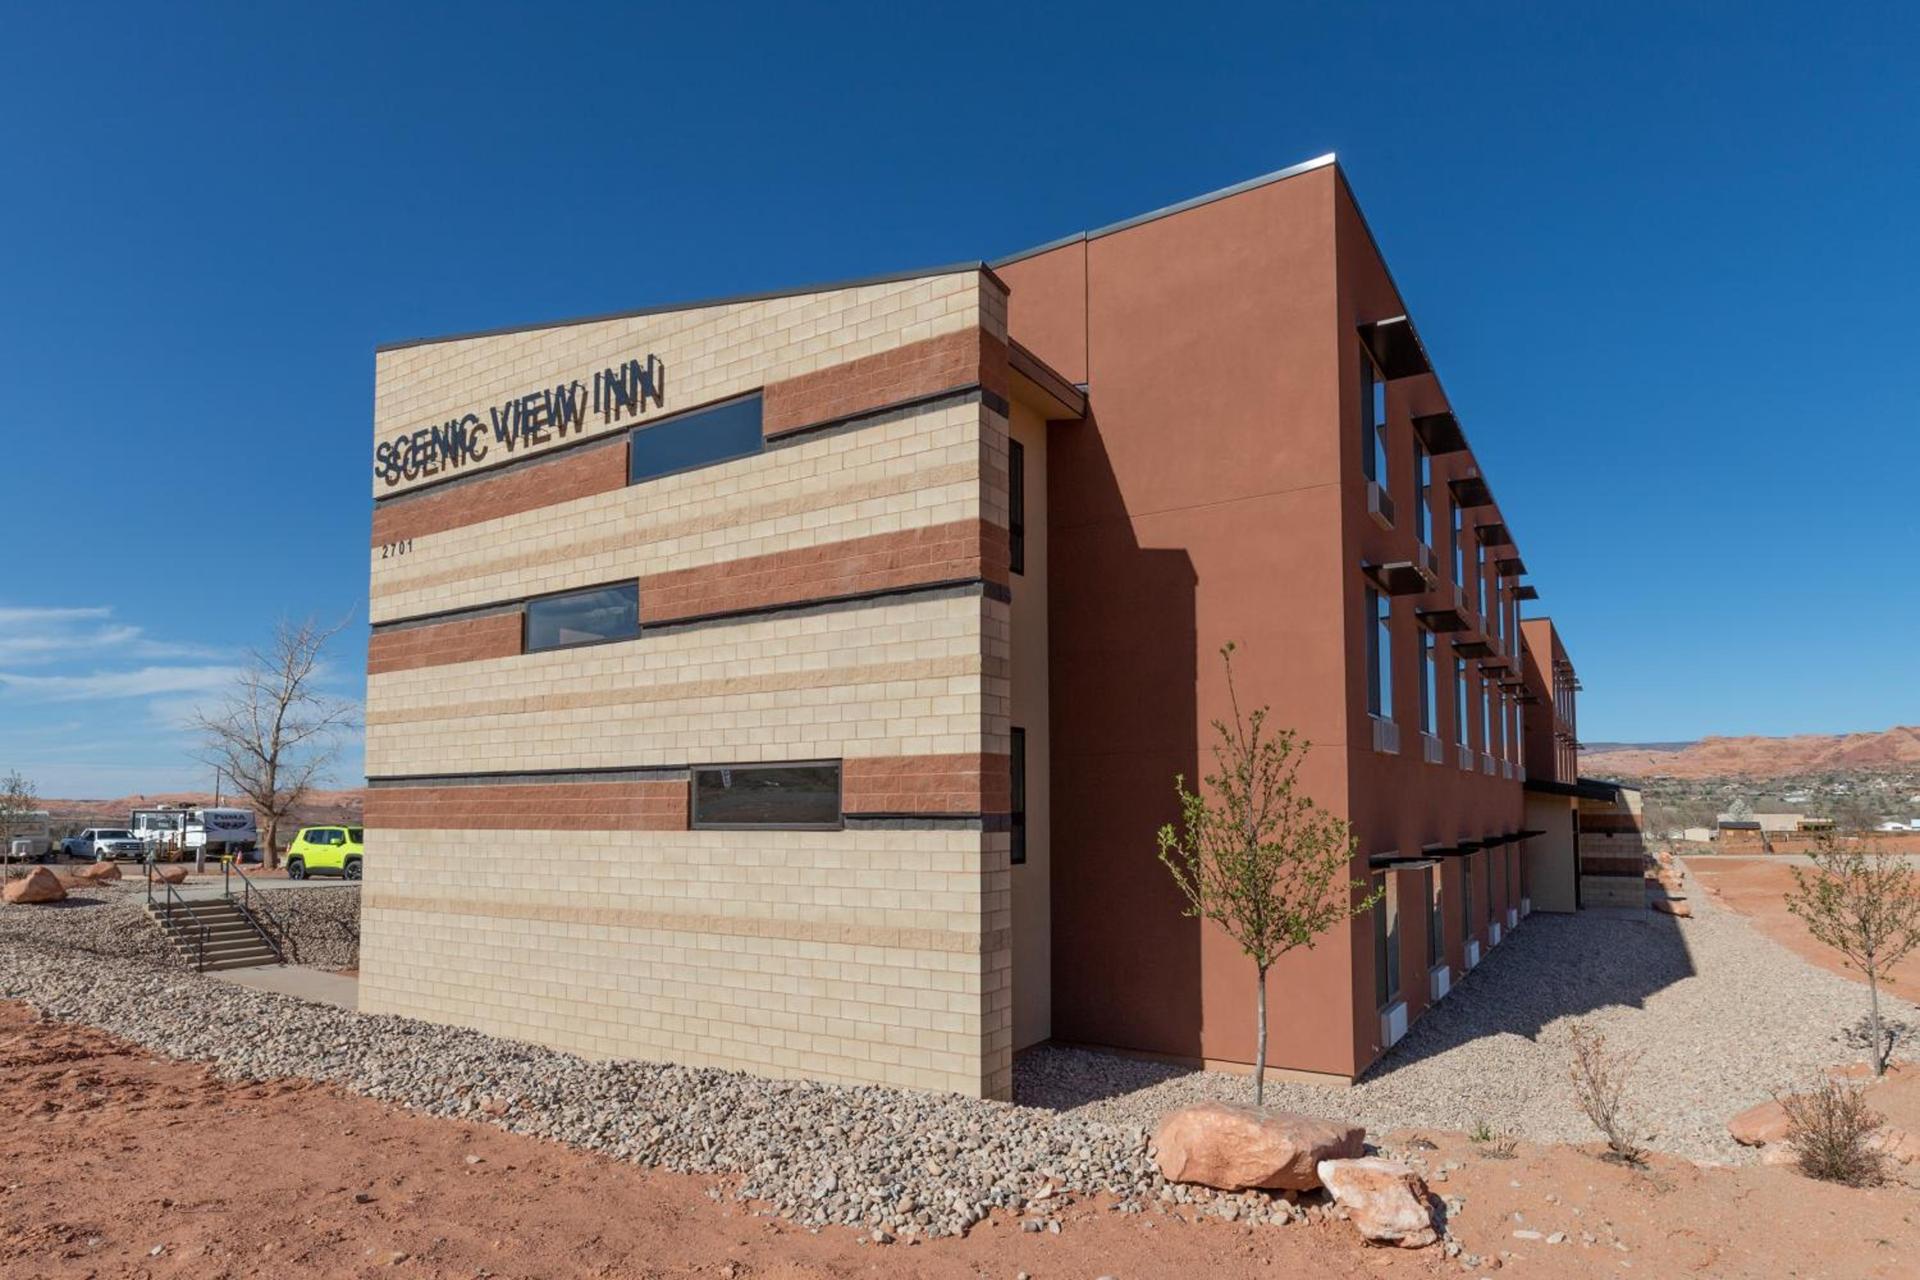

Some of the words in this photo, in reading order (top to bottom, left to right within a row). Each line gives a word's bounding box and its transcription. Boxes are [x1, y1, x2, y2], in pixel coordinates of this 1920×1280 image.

[375, 413, 481, 480] SCENIC
[489, 380, 580, 445] VIEW
[594, 354, 657, 417] INN
[382, 538, 412, 559] 2701
